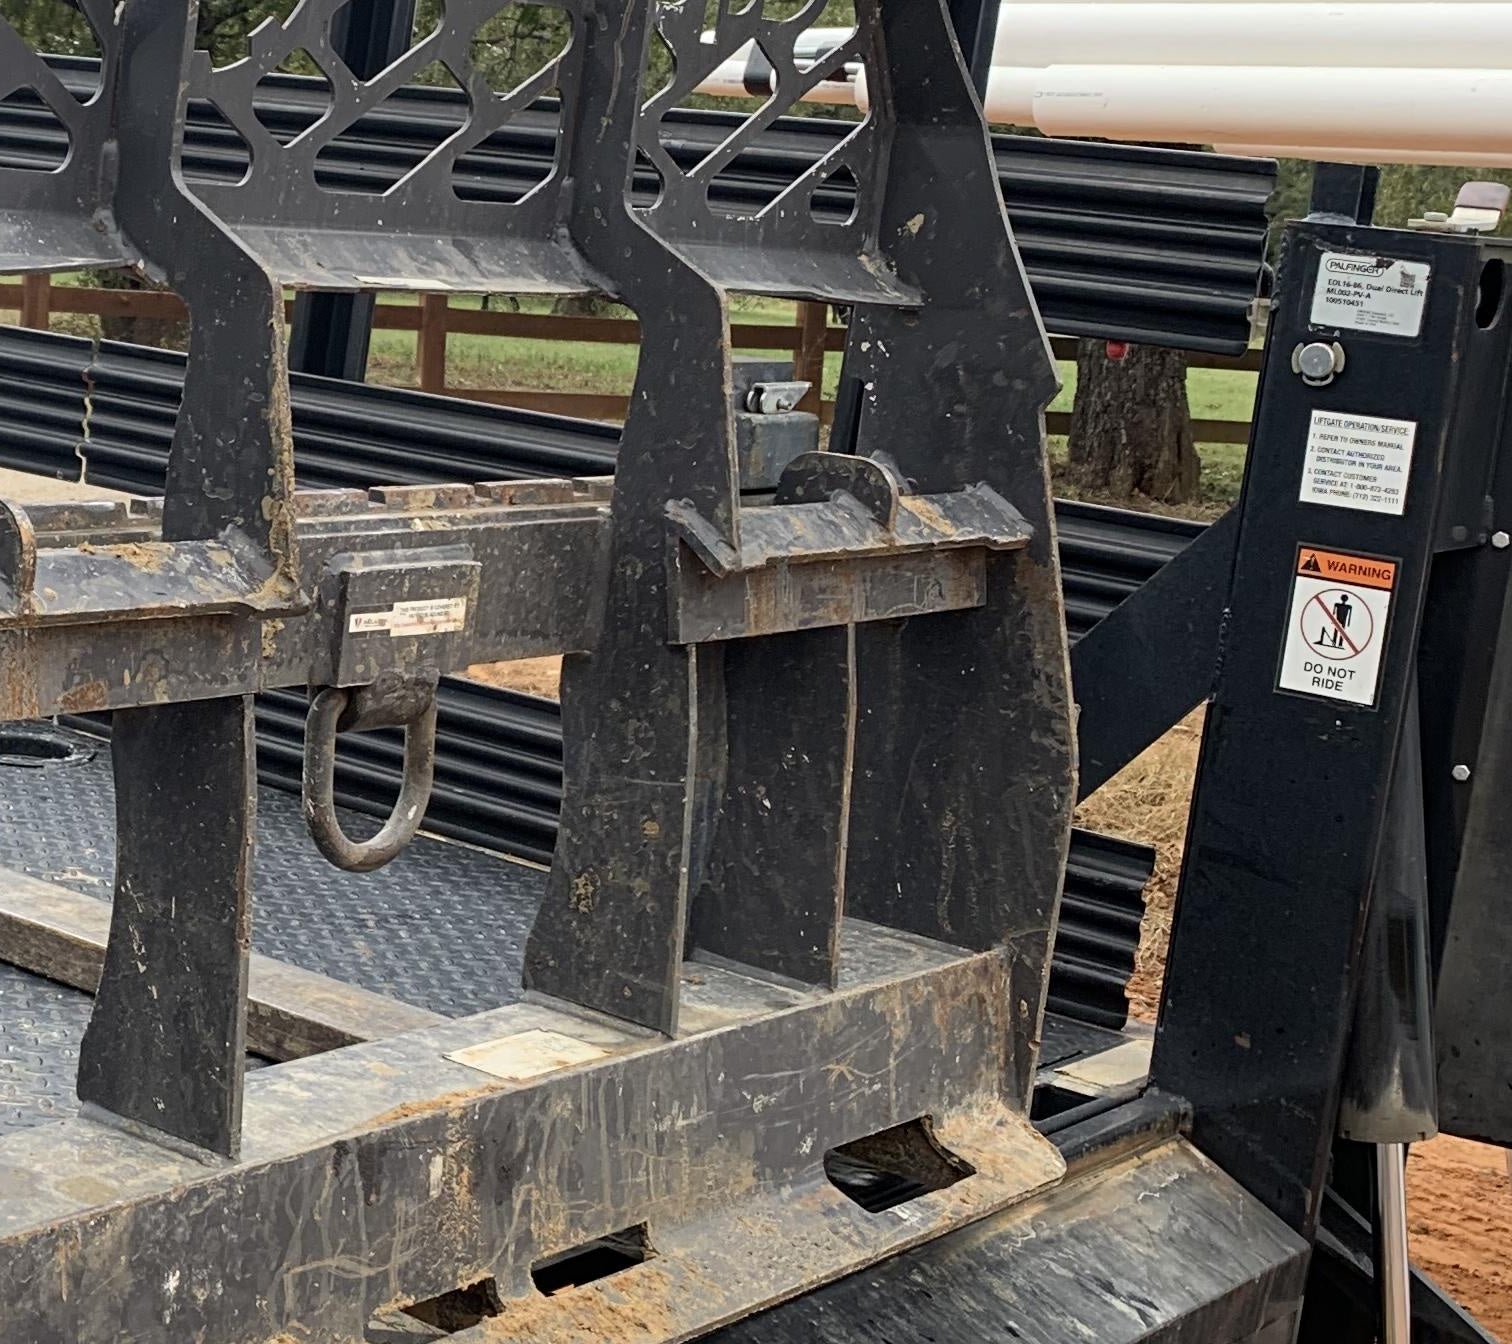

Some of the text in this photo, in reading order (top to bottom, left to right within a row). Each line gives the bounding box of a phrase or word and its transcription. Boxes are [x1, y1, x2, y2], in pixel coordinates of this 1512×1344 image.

[1330, 261, 1379, 274] PALFINGER
[1366, 284, 1384, 292] Dual
[1386, 286, 1408, 295] Direct
[1314, 416, 1342, 428] LIFTGATE
[1319, 433, 1338, 442] REFER
[1317, 446, 1345, 456] CONTACT
[1347, 450, 1385, 461] AUTHORIZED
[1316, 456, 1357, 466] DISTRIBUTOR
[1366, 462, 1384, 470] YOUR
[1314, 468, 1342, 478] CONTACT
[1343, 472, 1377, 482] CUSTOMER
[1313, 478, 1338, 487] SERVICE
[1326, 559, 1391, 581] WARNING
[1304, 661, 1356, 680] DO NOT
[1311, 676, 1344, 692] RIDE
